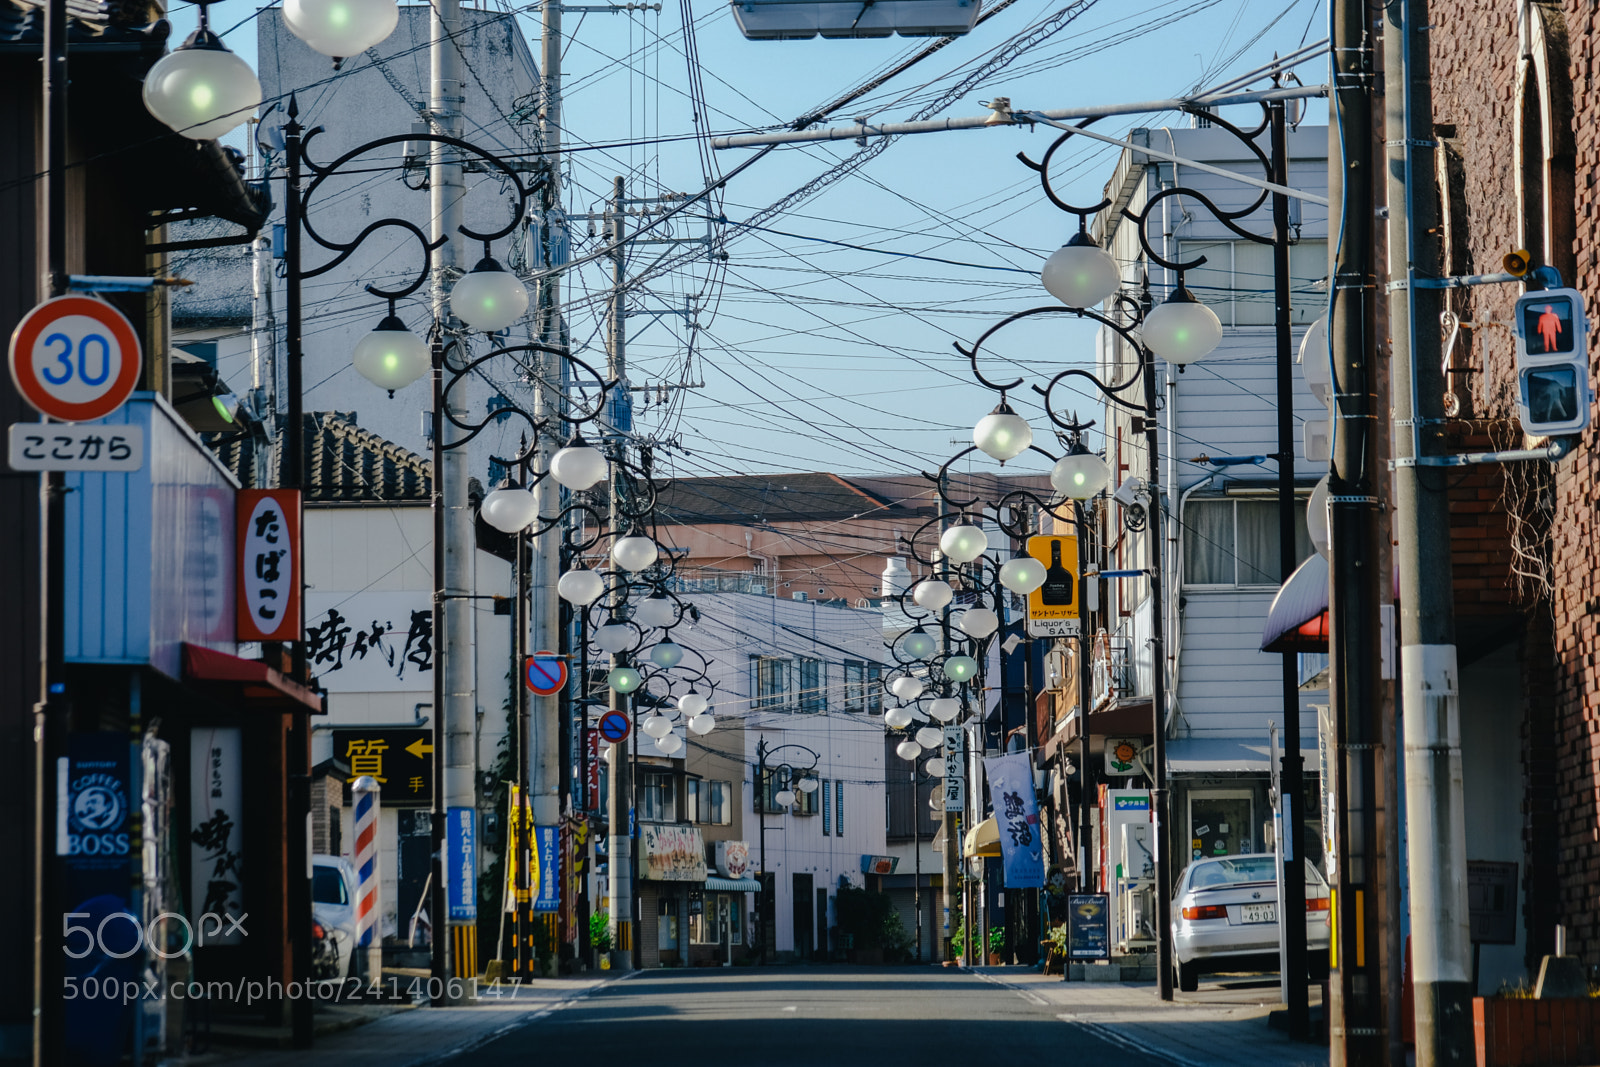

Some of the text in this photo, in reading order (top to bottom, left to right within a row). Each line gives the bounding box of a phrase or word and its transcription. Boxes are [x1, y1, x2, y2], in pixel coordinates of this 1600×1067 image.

[42, 333, 110, 386] 30
[23, 435, 132, 461] ここから
[255, 509, 287, 620] たばこ
[1034, 620, 1071, 630] Liquor's
[345, 738, 389, 784] 質
[72, 773, 122, 791] COFFEE
[68, 833, 130, 855] BOSS
